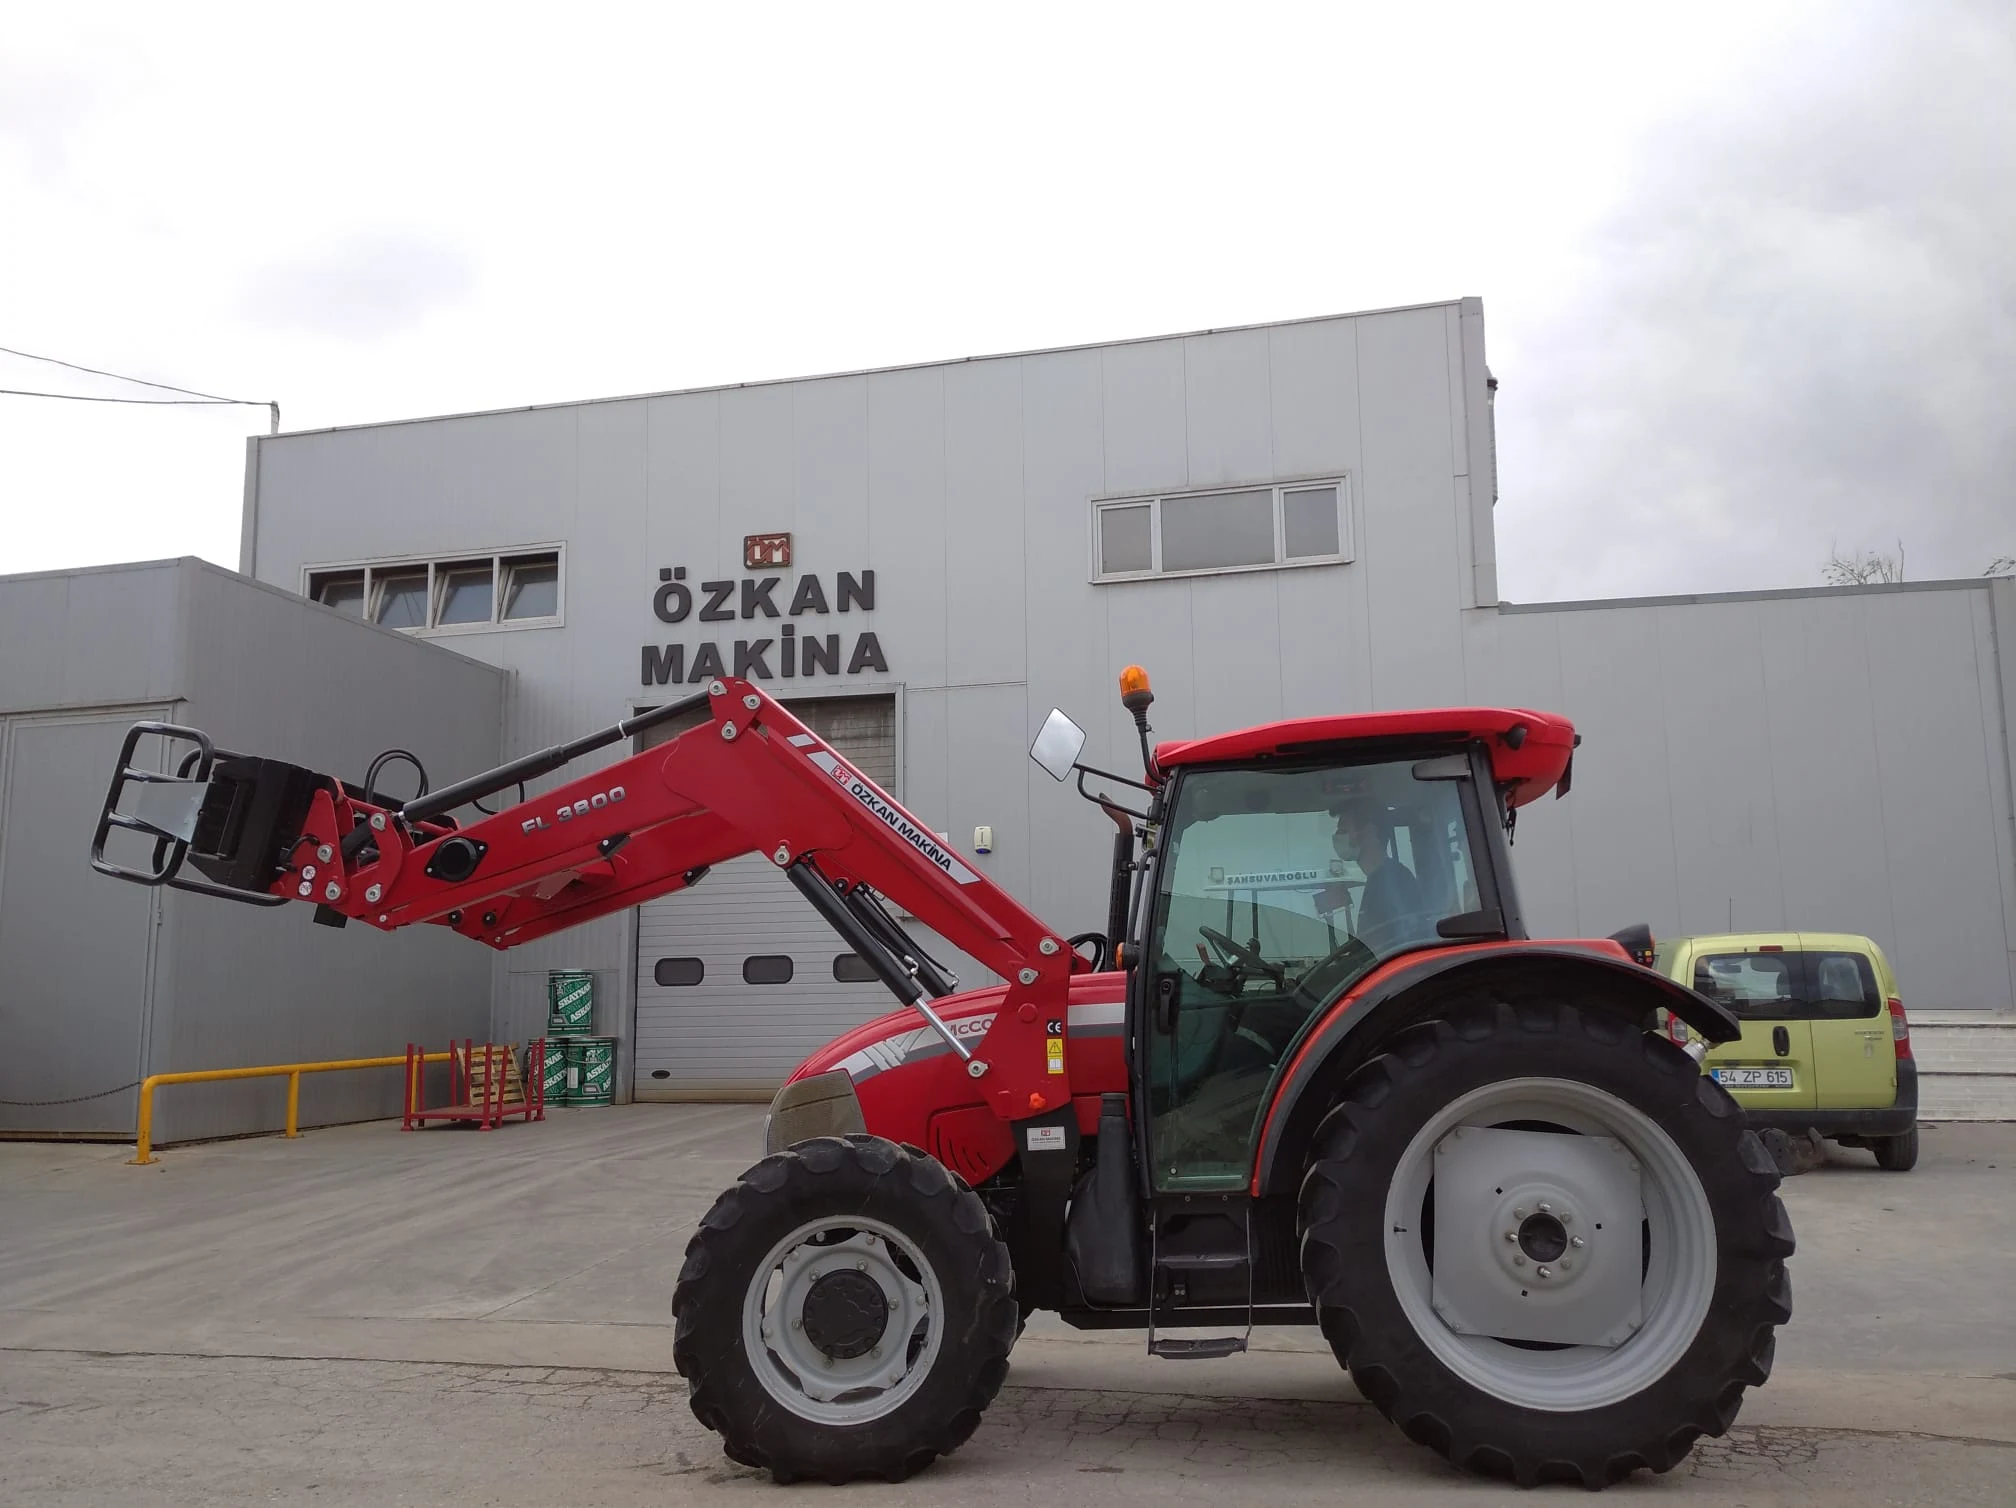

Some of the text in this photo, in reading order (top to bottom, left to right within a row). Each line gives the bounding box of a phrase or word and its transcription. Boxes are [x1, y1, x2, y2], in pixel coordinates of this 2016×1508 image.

[653, 566, 875, 623] ÖZKAN
[641, 624, 888, 685] MAKİNA
[521, 786, 626, 836] FL 3800
[851, 782, 952, 871] ÖZKAN MAKİNA
[1047, 1022, 1061, 1033] CE
[1720, 1071, 1788, 1083] 54 ZP 615
